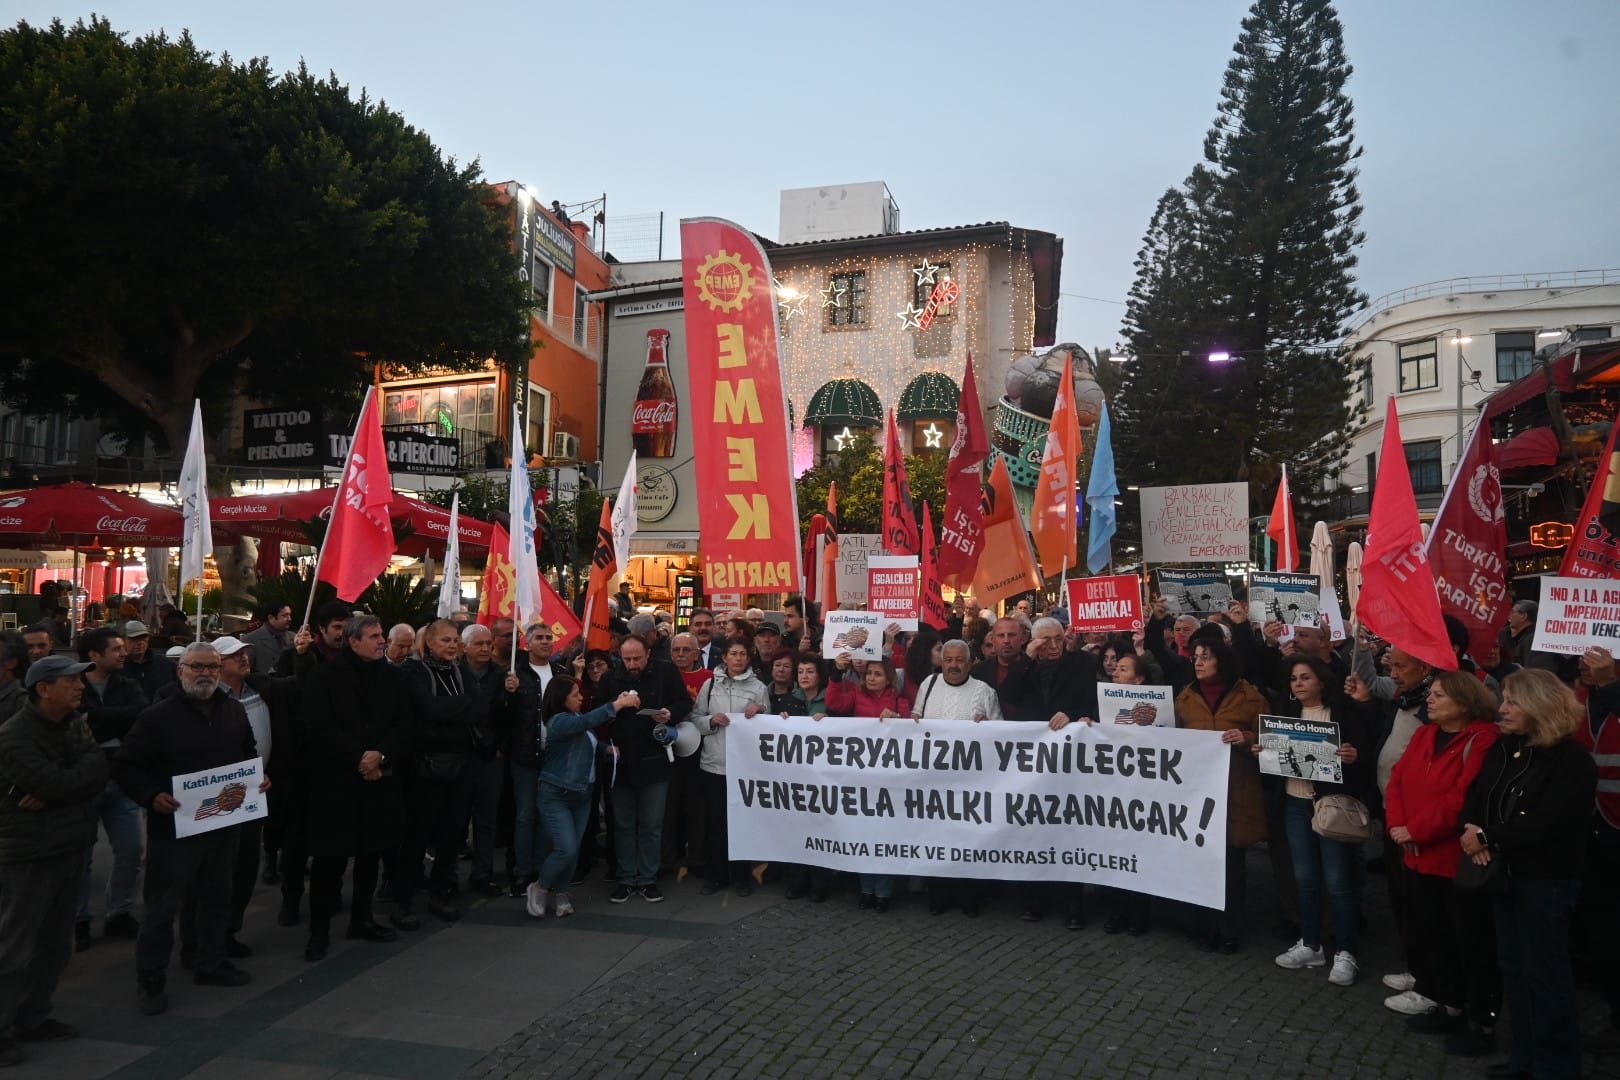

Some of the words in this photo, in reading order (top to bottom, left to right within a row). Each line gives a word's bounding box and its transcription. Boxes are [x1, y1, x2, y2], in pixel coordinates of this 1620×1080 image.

[252, 410, 311, 429] TATTOO
[274, 428, 287, 443] &
[387, 440, 398, 462] &
[219, 504, 242, 515] Gerçek
[243, 503, 267, 514] Mucize
[0, 516, 23, 526] cize
[427, 520, 450, 532] Gerçe
[1160, 570, 1186, 579] Yankee
[1252, 574, 1280, 584] Yankee
[1280, 576, 1290, 584] Go
[1291, 577, 1318, 586] Home!
[871, 585, 885, 597] HER
[887, 585, 915, 597] ZAMAN
[1086, 580, 1119, 600] DEFOL
[1572, 588, 1580, 602] A
[1584, 588, 1598, 603] LA
[873, 598, 913, 610] KAYBEDER!
[1436, 575, 1498, 624] PARTİSİ
[1078, 598, 1132, 620] AMERİKA!
[843, 615, 878, 625] Amerika!
[1544, 619, 1587, 635] CONTRA
[1591, 622, 1620, 638] VENE
[1104, 688, 1123, 698] Katil
[1124, 690, 1166, 700] Amerika!
[1263, 718, 1293, 731] Yankee
[1293, 722, 1306, 731] Go
[1306, 723, 1336, 735] Home!
[759, 732, 983, 771] EMPERYALİZM
[994, 734, 1183, 785] YENİLECEK
[183, 776, 209, 791] Katil
[209, 765, 256, 785] Amerika!
[738, 778, 895, 818] VENEZUELA
[904, 788, 992, 825] HALKI
[804, 836, 870, 857] ANTALYA
[874, 843, 921, 859] EMEK
[924, 845, 945, 861] VE
[950, 847, 1057, 865] DEMOKRASİ
[1061, 847, 1138, 873] GÜÇLERİ
